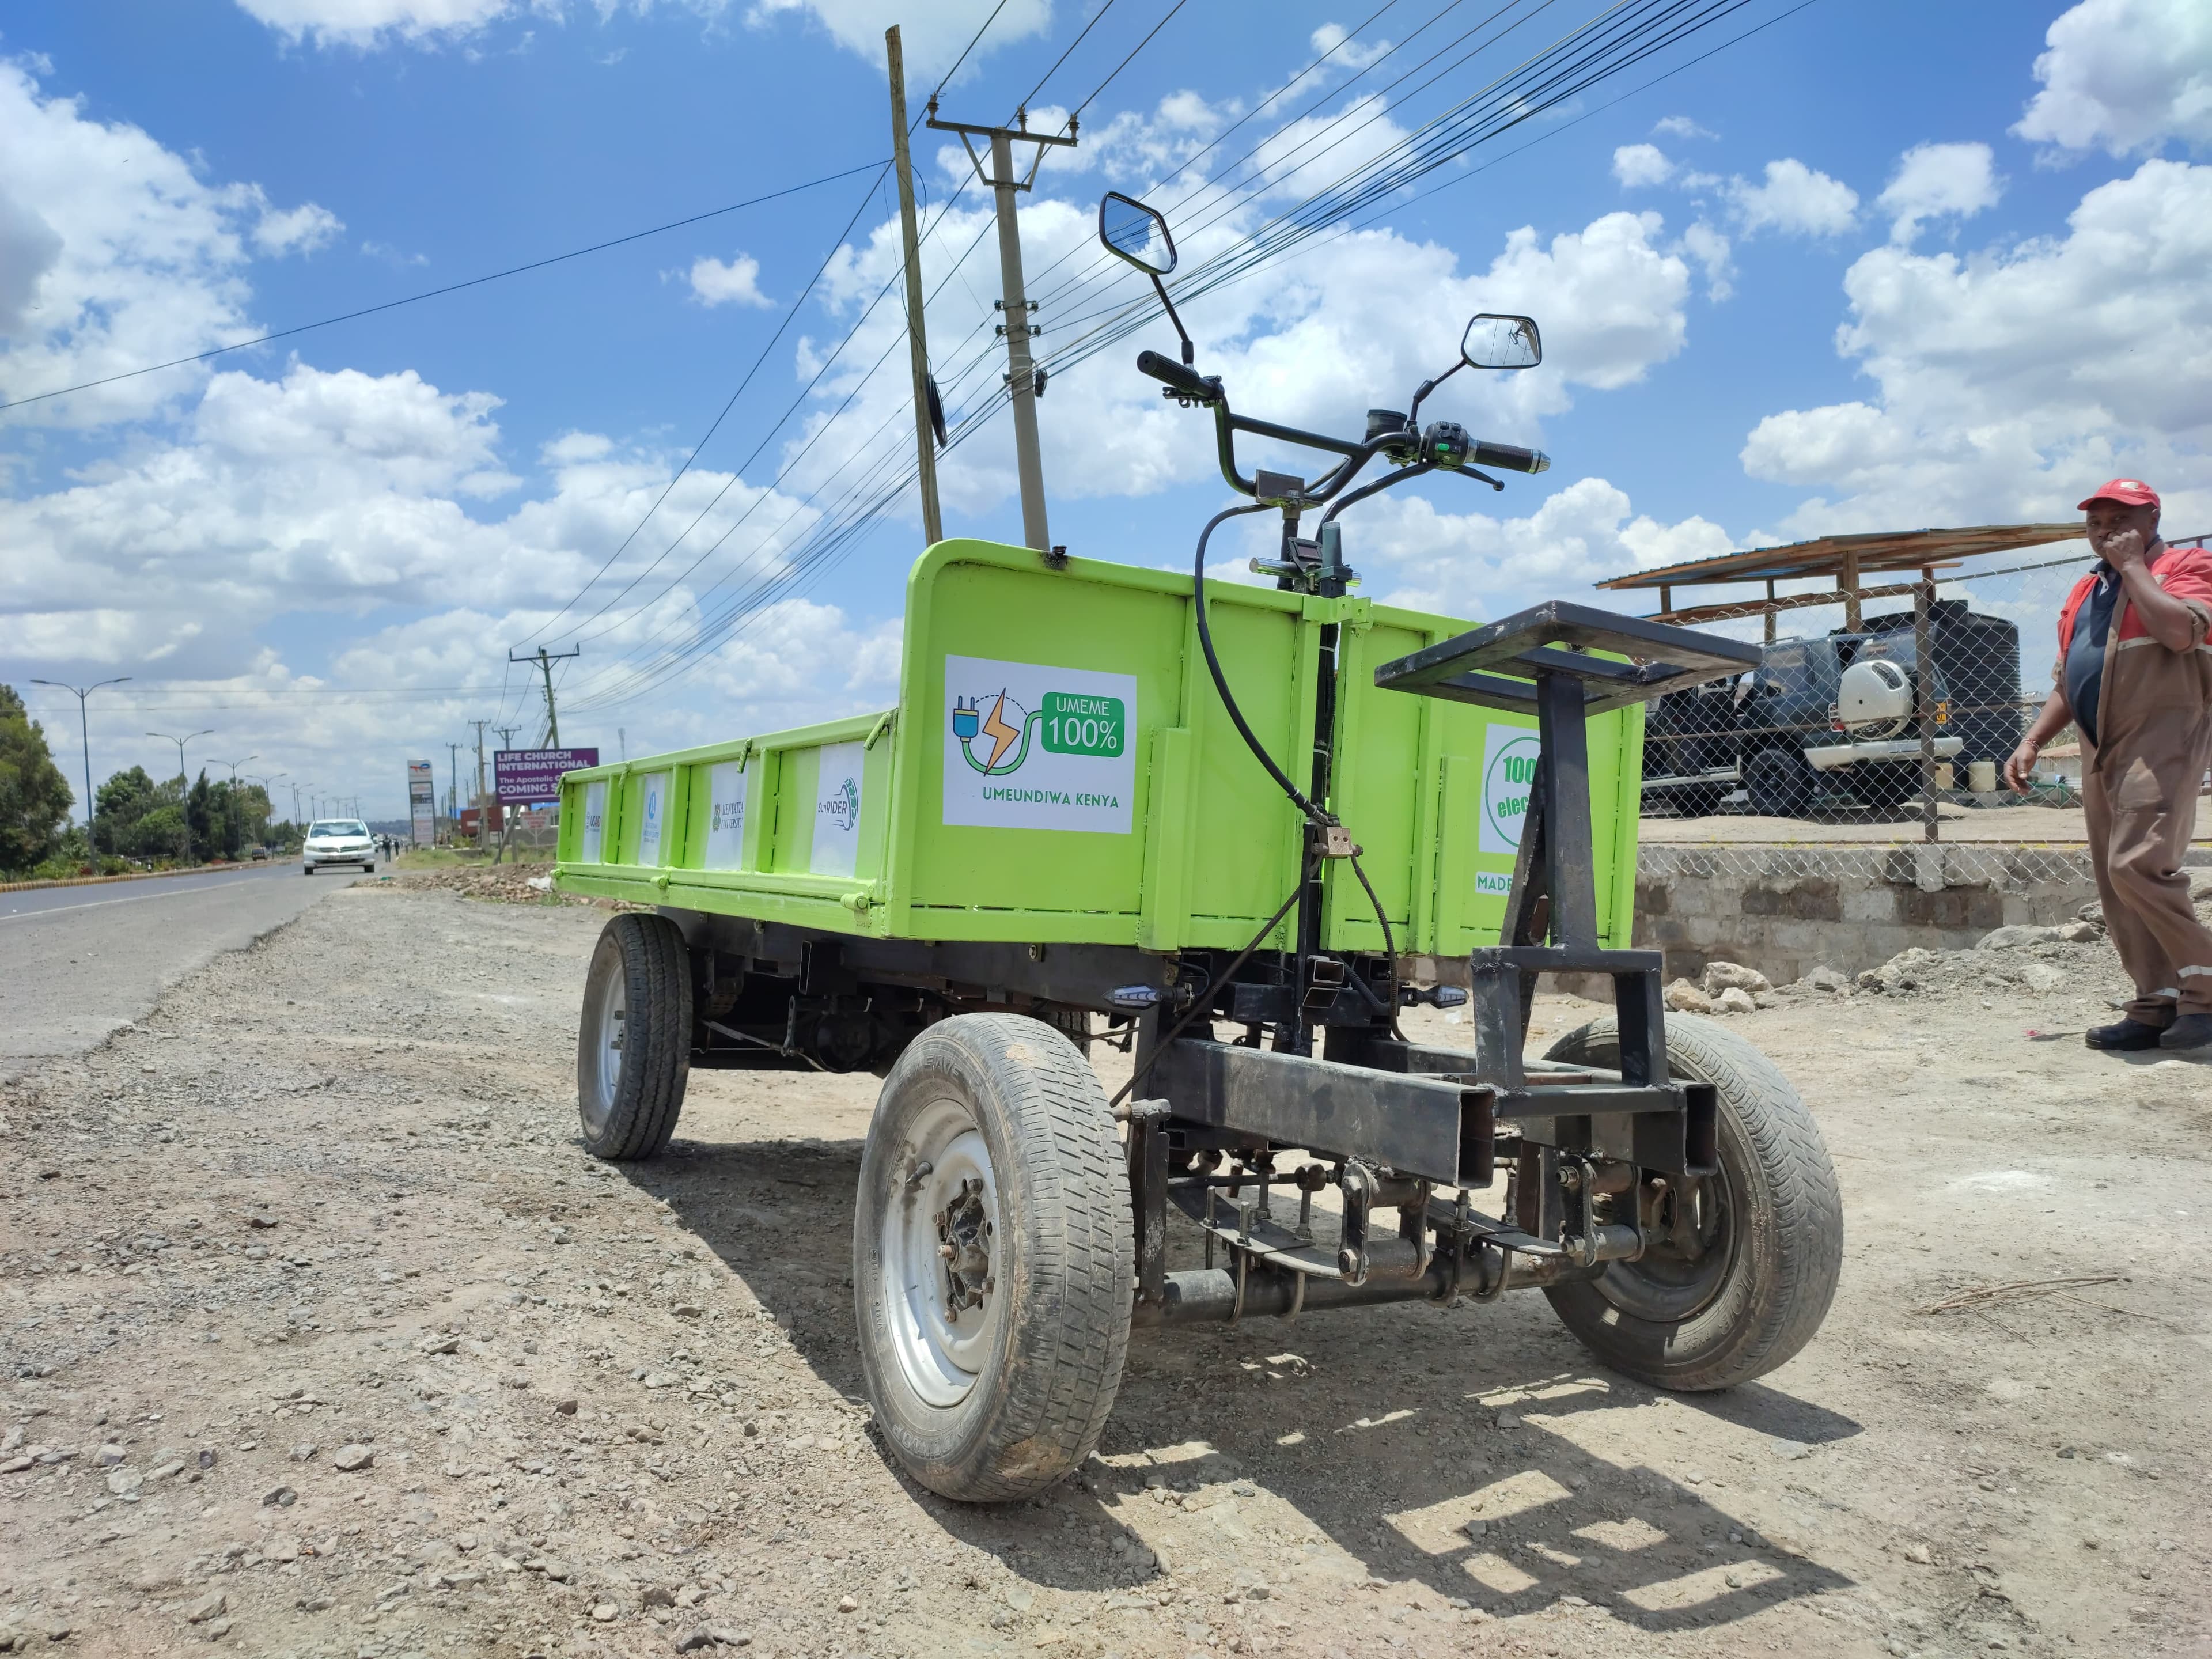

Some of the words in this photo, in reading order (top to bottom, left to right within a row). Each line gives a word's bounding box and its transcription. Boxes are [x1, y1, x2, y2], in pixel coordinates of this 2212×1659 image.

[1056, 696, 1110, 716] UMEME
[1048, 717, 1118, 749] 100%
[498, 753, 522, 762] LIFE
[524, 751, 571, 761] CHURCH
[498, 760, 590, 771] INTERNATIONAL
[517, 775, 553, 785] Apostolic
[498, 783, 548, 794] COMING
[983, 787, 1071, 805] UMEUNDIWA
[1075, 793, 1119, 808] KENYA
[722, 801, 743, 816] KENYATTA
[818, 801, 847, 814] SunRIDER
[590, 815, 601, 827] USAID
[721, 817, 743, 830] UNIVERSITY
[1478, 874, 1512, 891] MADE
